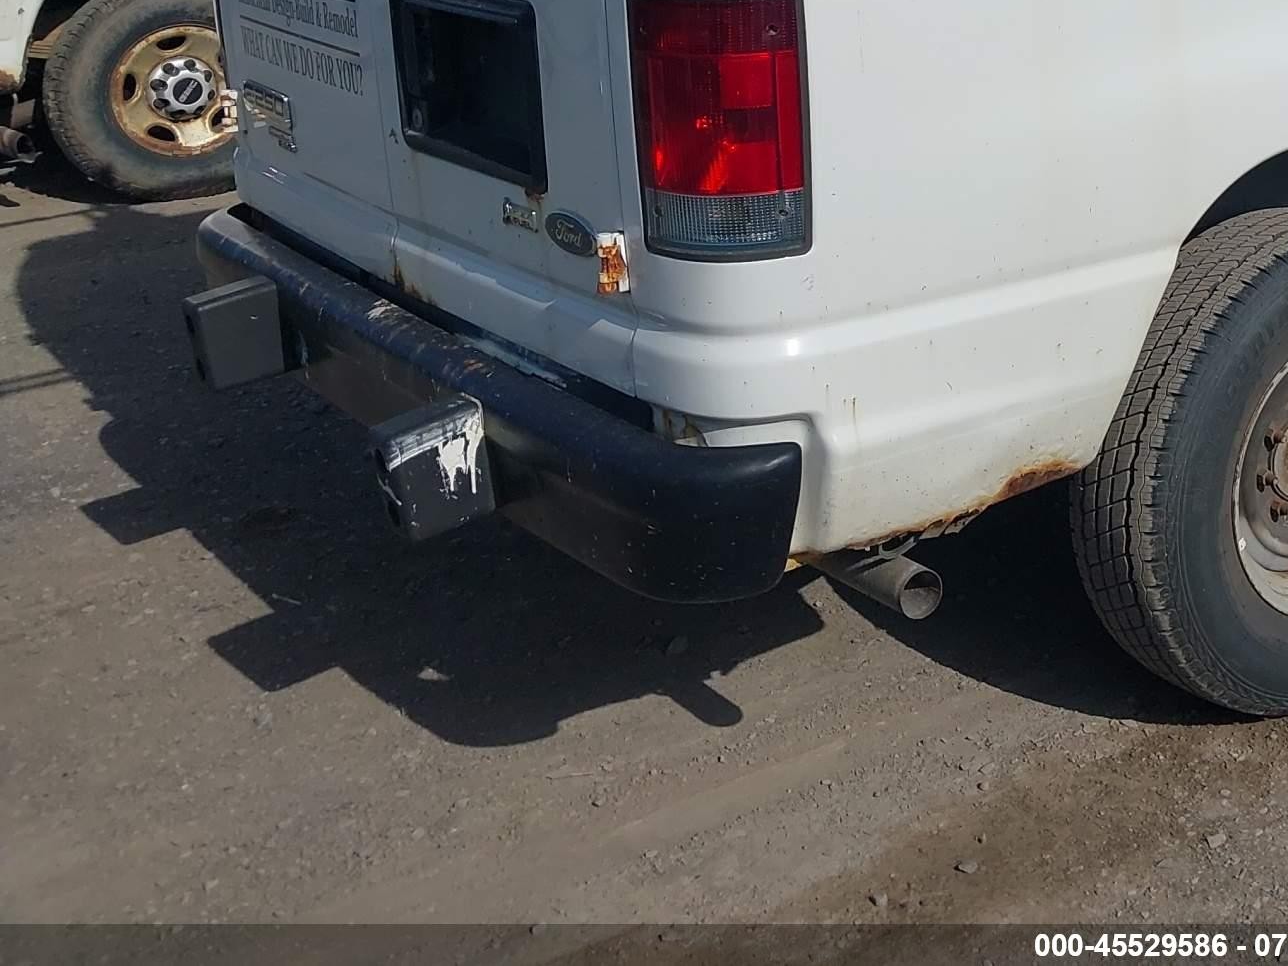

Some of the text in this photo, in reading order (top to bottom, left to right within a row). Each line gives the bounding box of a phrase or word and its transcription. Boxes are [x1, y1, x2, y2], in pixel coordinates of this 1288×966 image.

[322, 1, 358, 38] Remodel
[240, 25, 363, 97] WHAT CAN WE DO FOR YOU?
